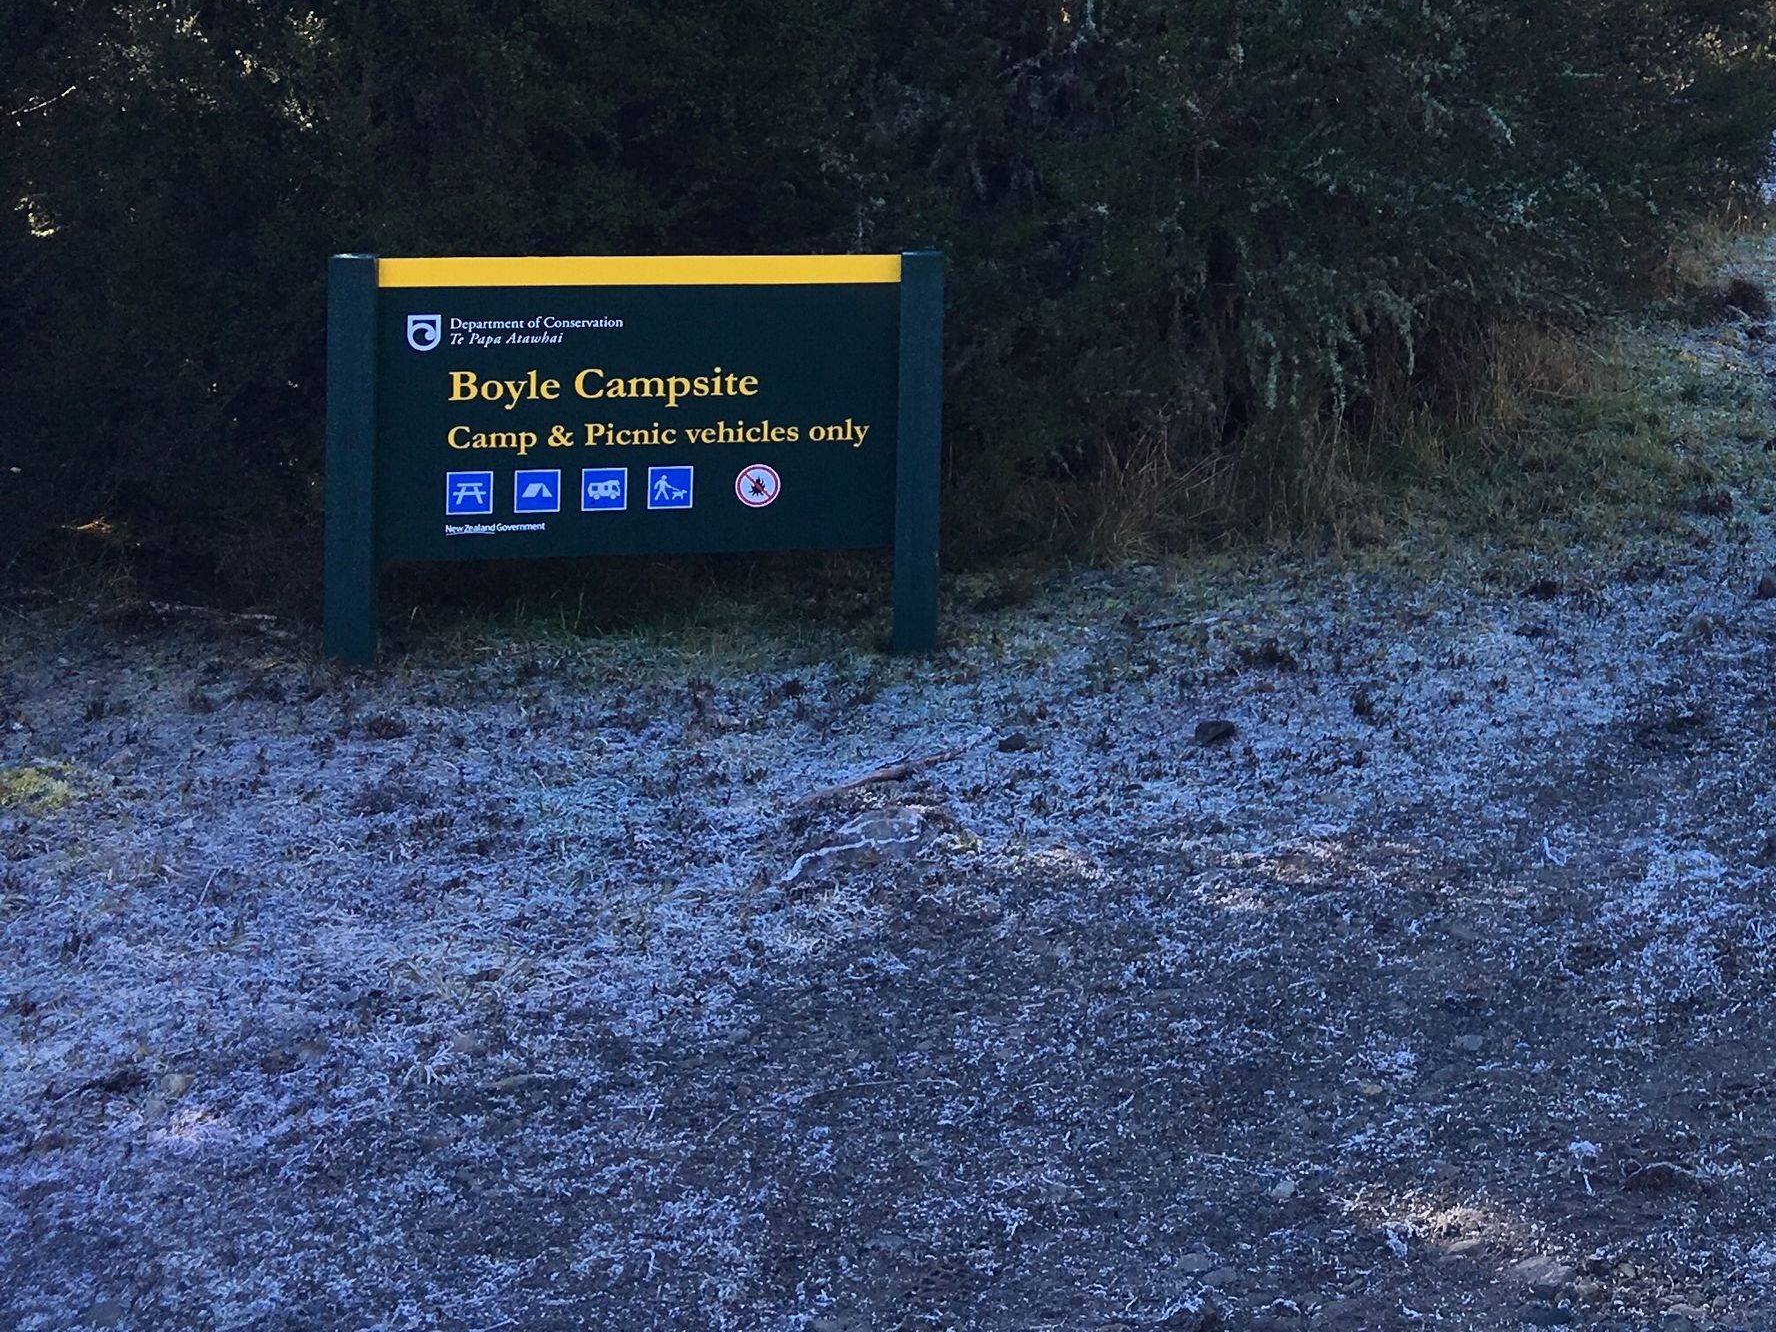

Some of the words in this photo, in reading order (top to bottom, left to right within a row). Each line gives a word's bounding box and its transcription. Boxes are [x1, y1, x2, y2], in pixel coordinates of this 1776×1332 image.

[450, 318, 524, 332] Department
[527, 316, 541, 328] of
[543, 316, 624, 329] Conservation
[450, 333, 464, 345] Te
[468, 333, 501, 348] Papa
[506, 332, 563, 345] Atawhai
[448, 370, 561, 409] Boyle
[574, 366, 759, 407] Campsite
[447, 425, 537, 456] Camp
[547, 426, 574, 447] &
[584, 423, 676, 446] Picnic
[685, 420, 799, 444] vehicles
[808, 419, 870, 447] only
[445, 524, 463, 533] New
[464, 524, 496, 534] Zealand
[496, 522, 545, 532] Government
